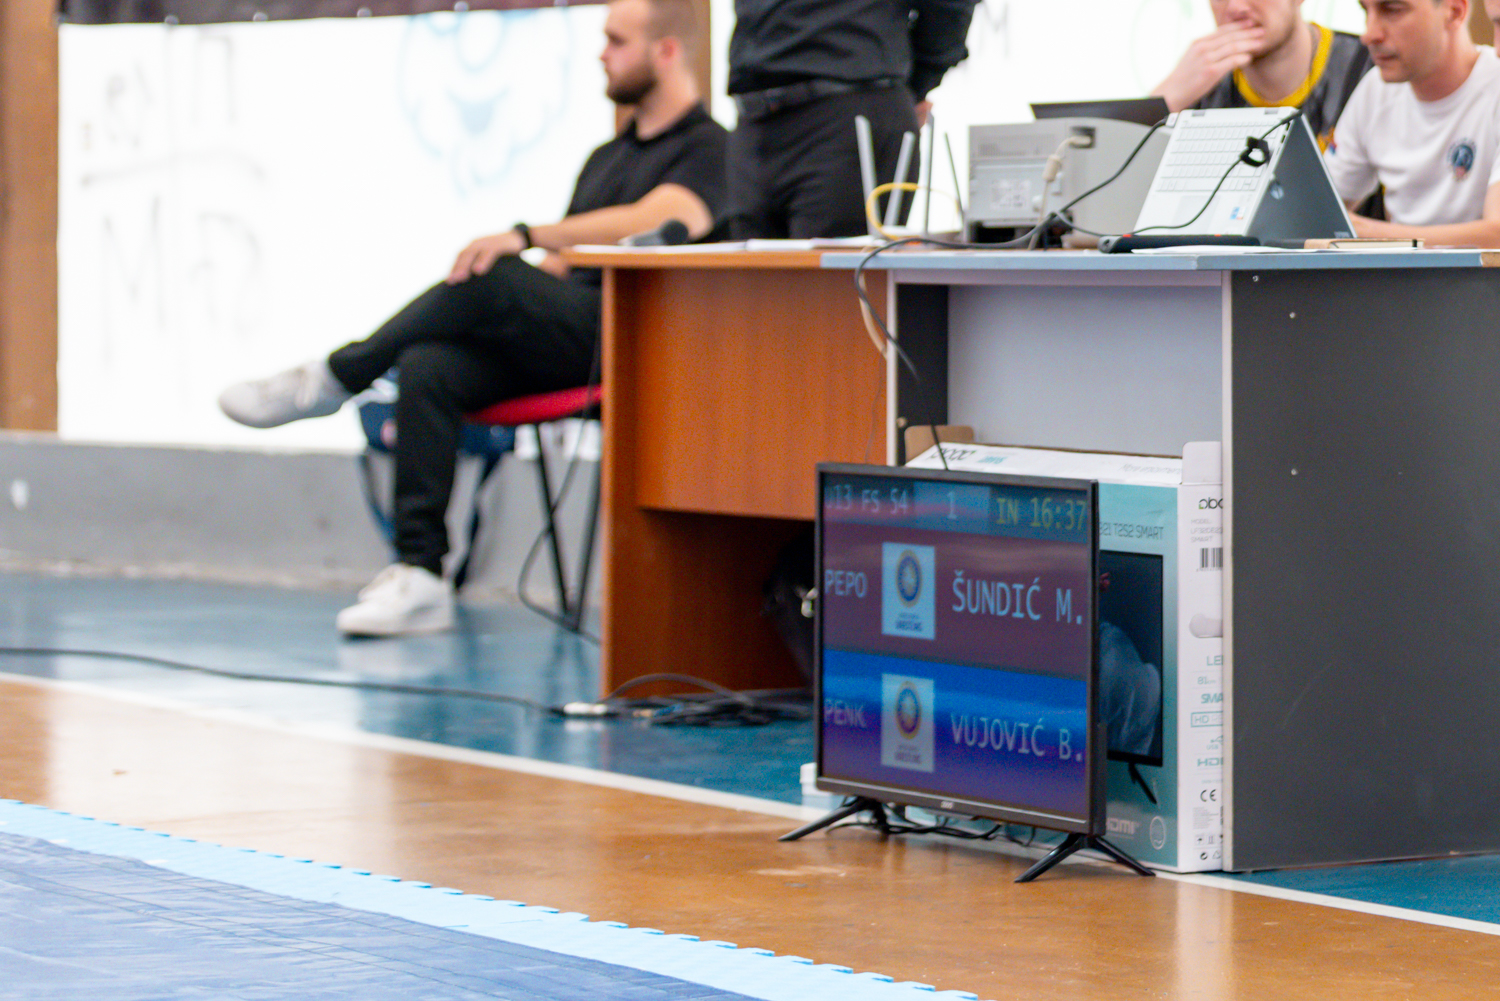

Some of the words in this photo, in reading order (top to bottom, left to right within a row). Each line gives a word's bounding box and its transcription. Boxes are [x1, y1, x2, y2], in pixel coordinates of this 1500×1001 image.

[946, 488, 958, 520] 1
[996, 497, 1019, 525] IN
[1030, 496, 1087, 531] 16:37
[1135, 524, 1165, 540] SMART
[824, 569, 868, 598] PEPO
[952, 569, 1042, 621] ŠUNDIĆ
[1055, 587, 1083, 625] M.
[950, 713, 1046, 757] VUJOVIĆ
[1058, 728, 1083, 763] B.
